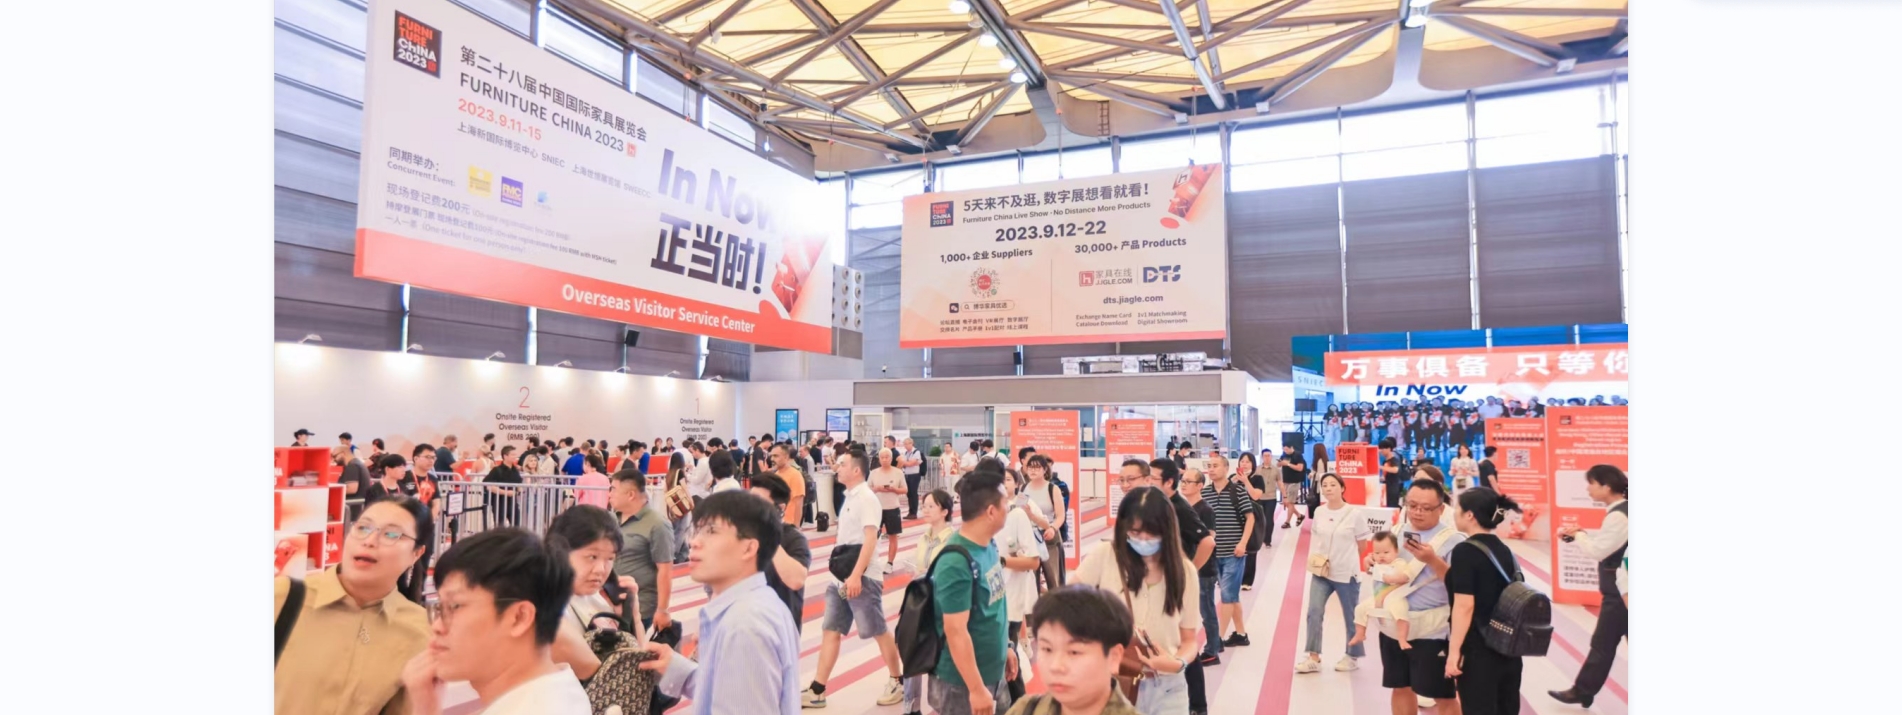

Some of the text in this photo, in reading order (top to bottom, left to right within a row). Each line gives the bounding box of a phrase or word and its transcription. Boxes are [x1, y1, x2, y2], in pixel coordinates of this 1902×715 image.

[398, 16, 434, 40] FURNI
[398, 26, 427, 47] TURE
[398, 48, 428, 68] 2023
[460, 45, 647, 142] 第二十八届中国国际家具展览会
[458, 98, 542, 141] 2023.9.11-15
[460, 72, 548, 122] FURNITURE
[552, 112, 592, 140] CHINA
[595, 130, 624, 152] 2023
[457, 122, 538, 159] 上海新国际博览中心
[541, 153, 566, 168] SNIEC
[389, 146, 440, 172] 同期举办：
[387, 160, 432, 180] Concurrent
[432, 174, 456, 187] Event:
[658, 148, 697, 205] In
[387, 182, 470, 216] 现场登记费200元
[962, 214, 992, 224] Furniture
[994, 212, 1012, 221] China
[1029, 210, 1048, 218] Show
[1053, 208, 1064, 216] No
[1064, 205, 1096, 214] Distance
[1098, 204, 1116, 212] More
[1118, 201, 1150, 210] Products
[994, 220, 1106, 242] 2023.9.12-22
[650, 212, 767, 295] 正当时！
[940, 248, 1033, 264] 1,000+ 企业 Suppliers
[1074, 238, 1186, 254] 30,000+ 产品 Products
[1095, 268, 1132, 278] 家具在线
[1142, 264, 1181, 284] DTS
[562, 284, 755, 334] Overseas Visitor Service Center
[1103, 295, 1164, 305] dts.jiagle.com
[1340, 351, 1628, 380] 万事俱备 只等你
[1298, 376, 1324, 388] SNIEC
[1376, 384, 1468, 396] In Now
[518, 386, 530, 408] 2
[695, 398, 700, 415] 1
[496, 412, 552, 422] Onsite Registered
